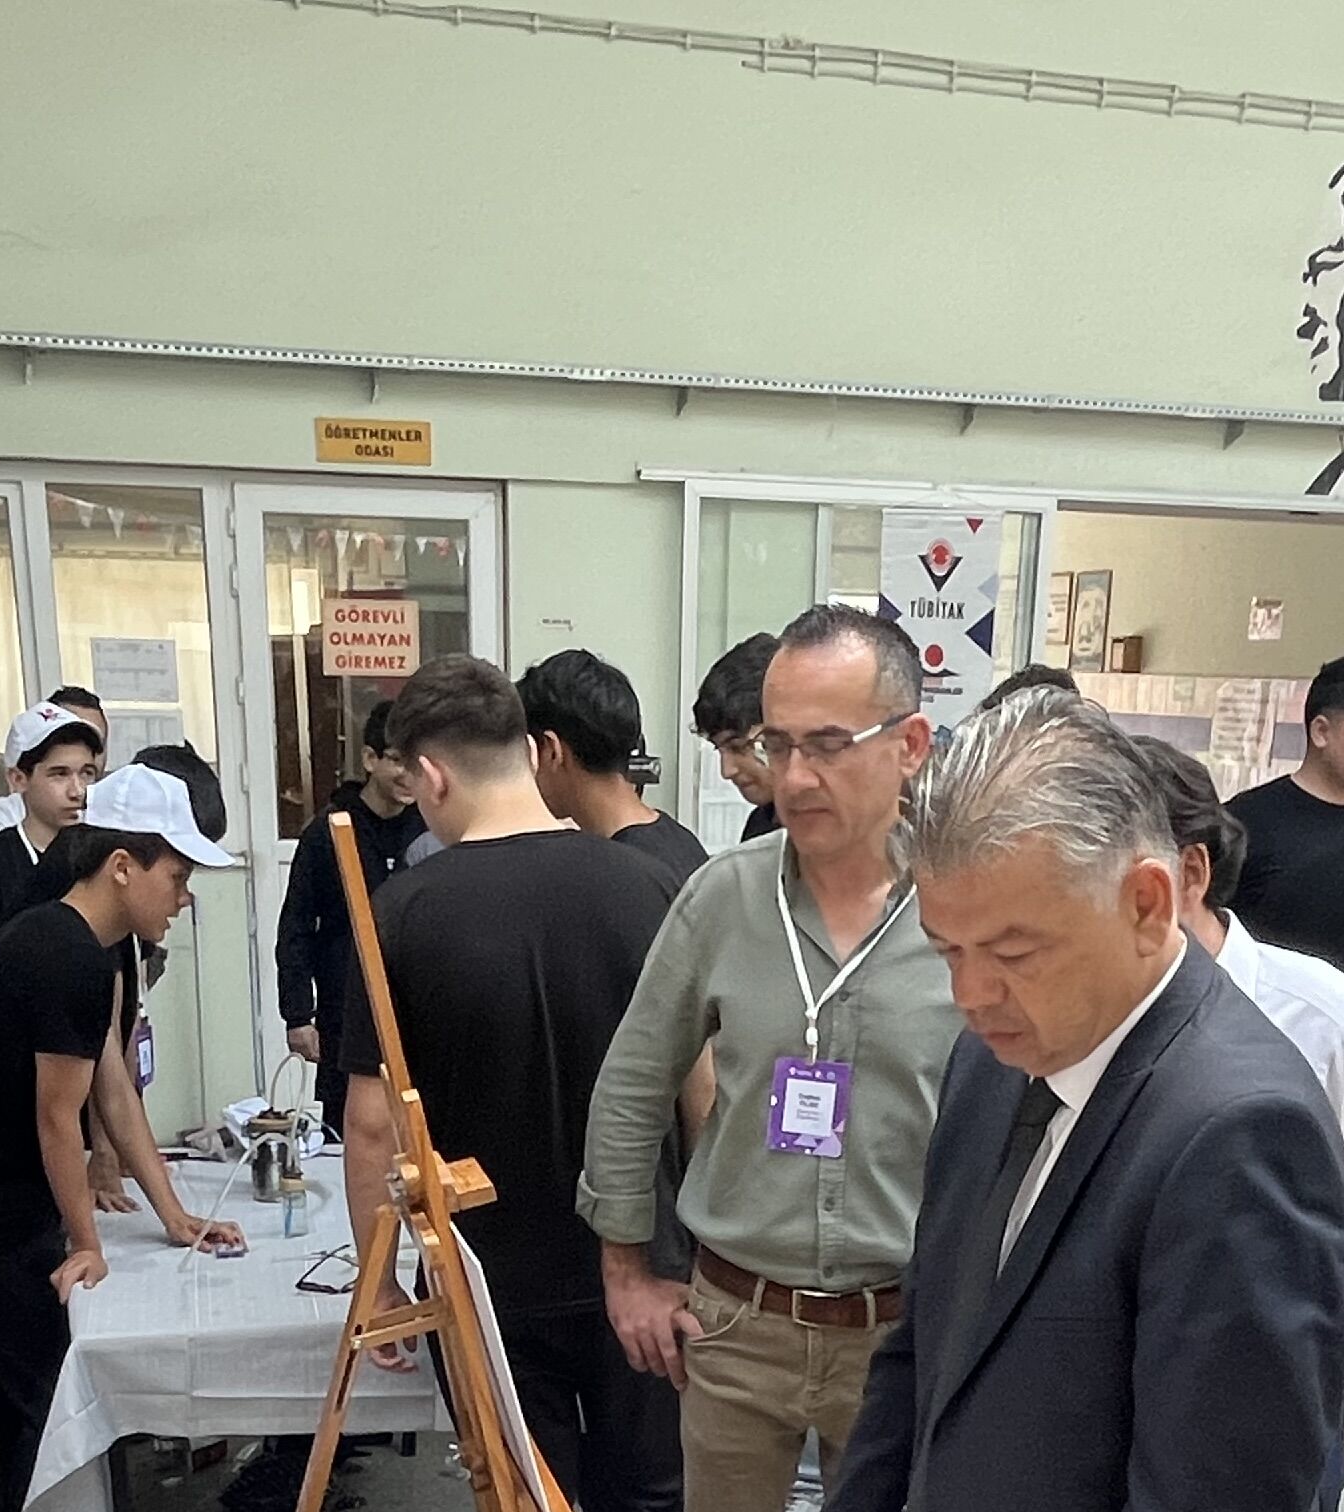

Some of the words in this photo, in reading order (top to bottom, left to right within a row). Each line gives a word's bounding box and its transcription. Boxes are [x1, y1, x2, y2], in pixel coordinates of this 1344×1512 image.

[354, 443, 395, 458] ODASI
[334, 604, 407, 625] GÖREVLİ
[910, 596, 965, 619] TÜBİTAK
[329, 631, 412, 647] OLMAYAN
[334, 651, 407, 670] GİREMEZ
